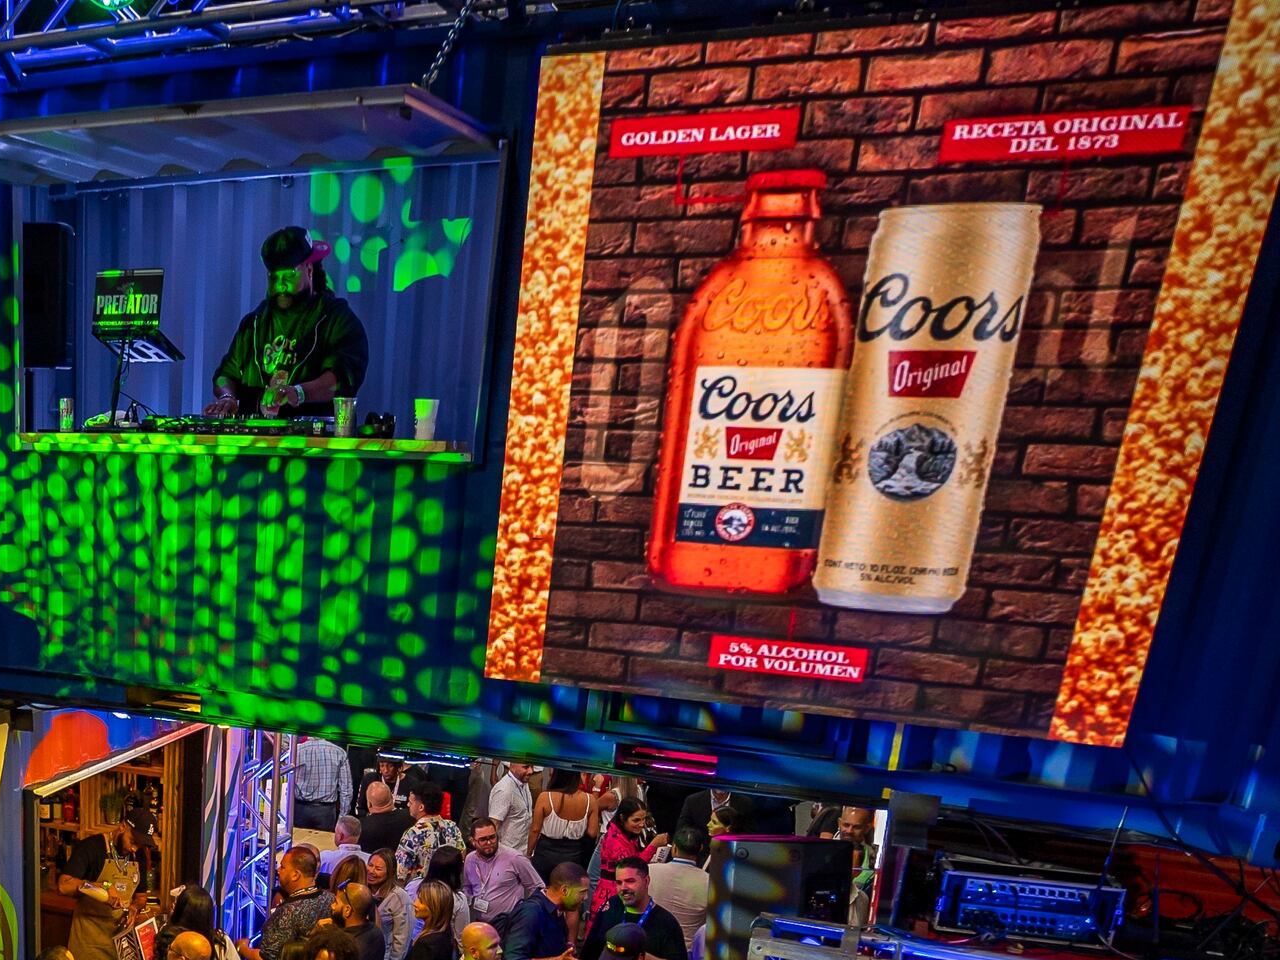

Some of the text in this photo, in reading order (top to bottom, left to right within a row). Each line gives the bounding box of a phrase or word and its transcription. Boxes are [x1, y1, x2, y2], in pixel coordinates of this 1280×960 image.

[620, 123, 781, 146] GOLDEN LAGER
[952, 112, 1184, 140] RECETA ORIGINAL
[1009, 134, 1120, 154] DEL 1873
[96, 294, 158, 315] PREDATOR
[857, 272, 1025, 343] Coors
[893, 355, 967, 392] Original
[699, 375, 816, 423] Coors
[730, 432, 777, 456] Original
[688, 464, 805, 494] BEER
[718, 653, 861, 679] POR VOLUMEN
[728, 642, 850, 665] 5% ALCOHOL
